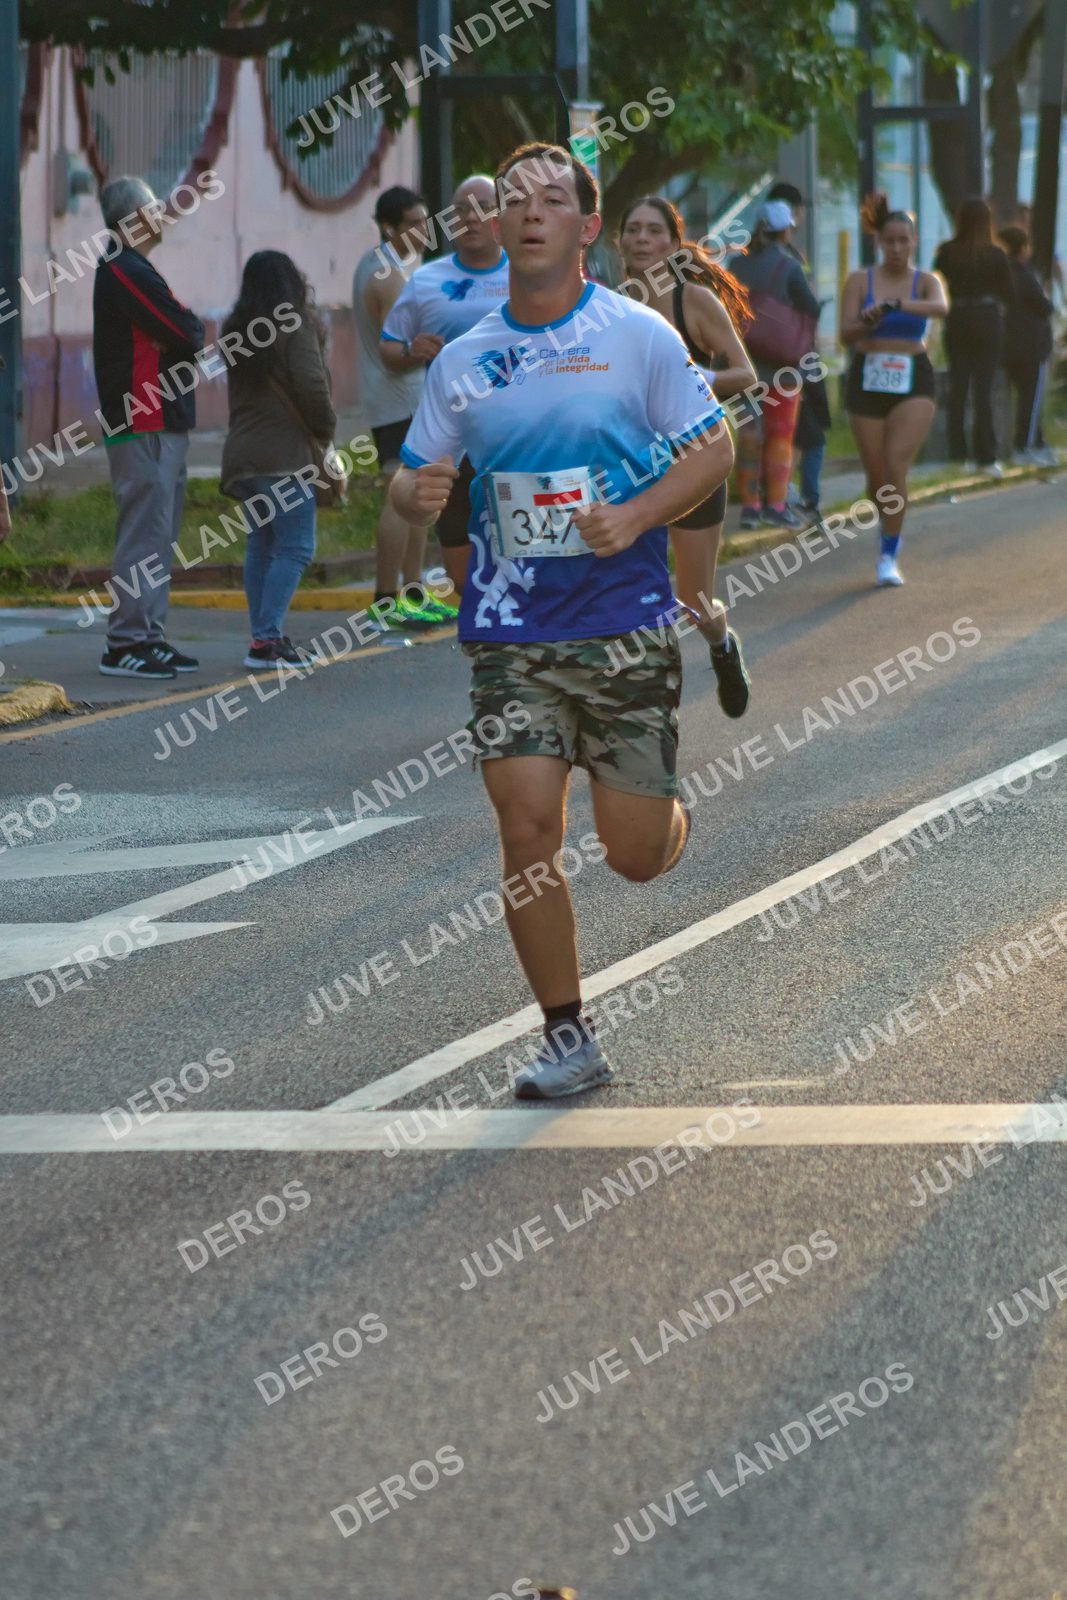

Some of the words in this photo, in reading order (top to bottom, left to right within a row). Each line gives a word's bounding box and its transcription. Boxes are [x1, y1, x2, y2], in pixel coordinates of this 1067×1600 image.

[567, 355, 591, 364] Vida
[870, 369, 902, 387] 238
[511, 508, 578, 546] 347
